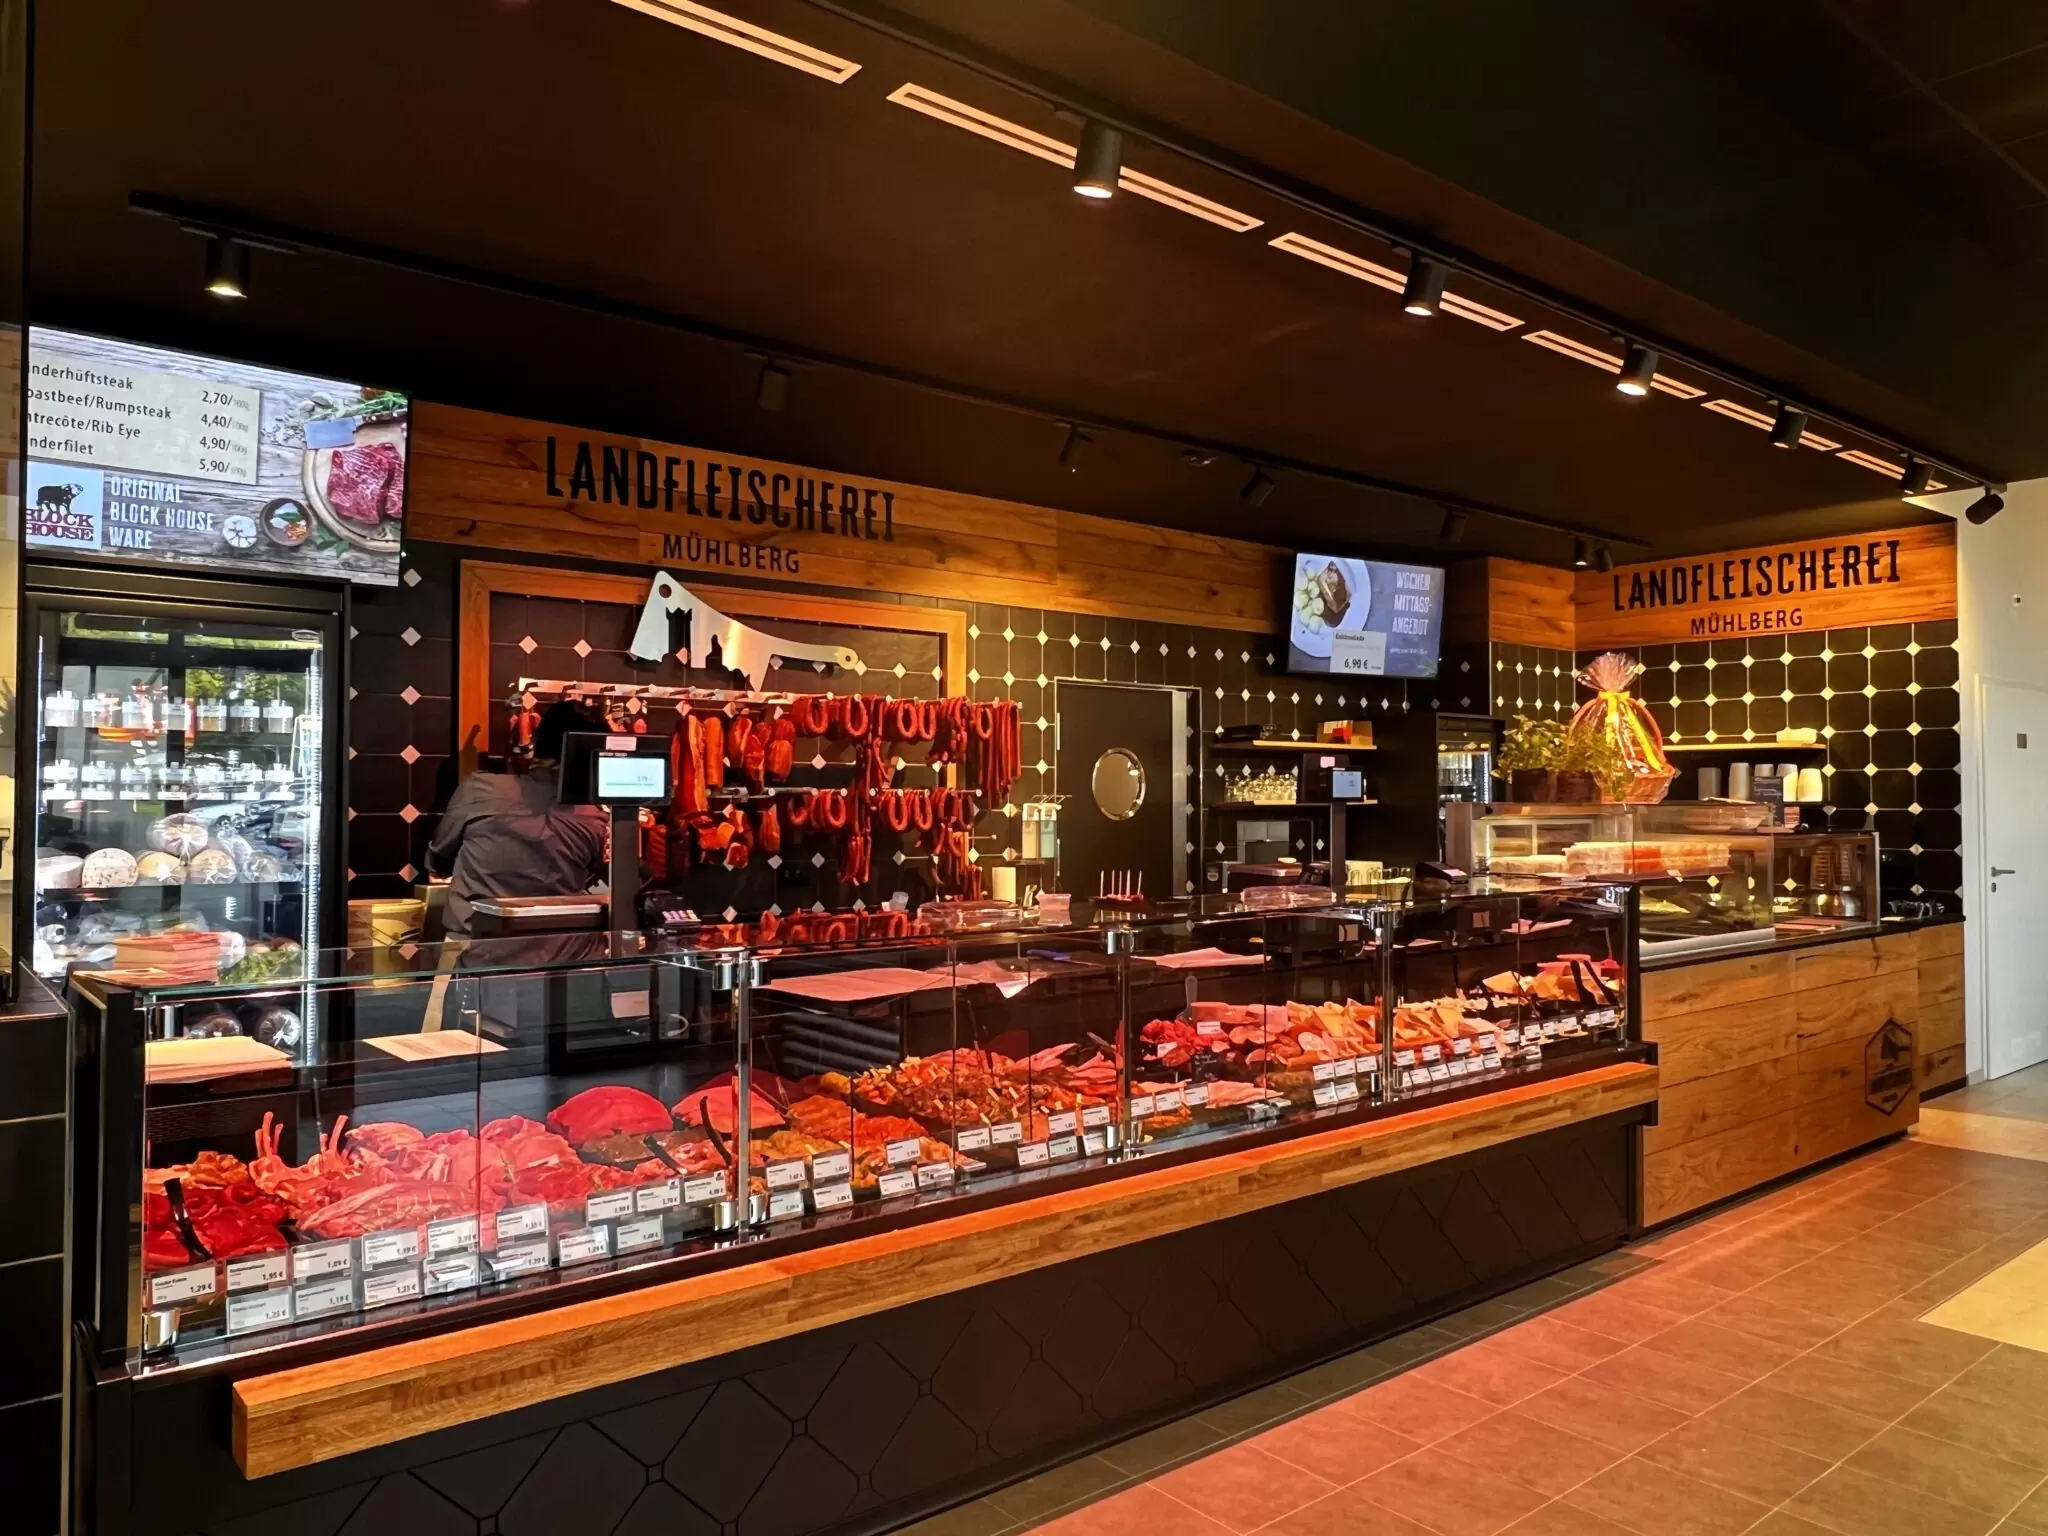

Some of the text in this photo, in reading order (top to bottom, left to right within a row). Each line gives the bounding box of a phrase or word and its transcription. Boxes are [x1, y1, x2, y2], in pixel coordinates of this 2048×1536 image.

[118, 423, 141, 440] Eye
[111, 476, 184, 504] ORIGINAL
[546, 436, 895, 542] LANDFLEISCHEREI
[110, 501, 216, 531] BLOCK HOUSE
[109, 526, 153, 549] WARE
[662, 531, 799, 573] MÜHLBERG
[1613, 539, 1900, 612] LANDFLEISCHEREI
[1690, 608, 1803, 636] MÜHLBERG
[1344, 658, 1369, 670] 6,90 €
[262, 1271, 278, 1281] 1,95
